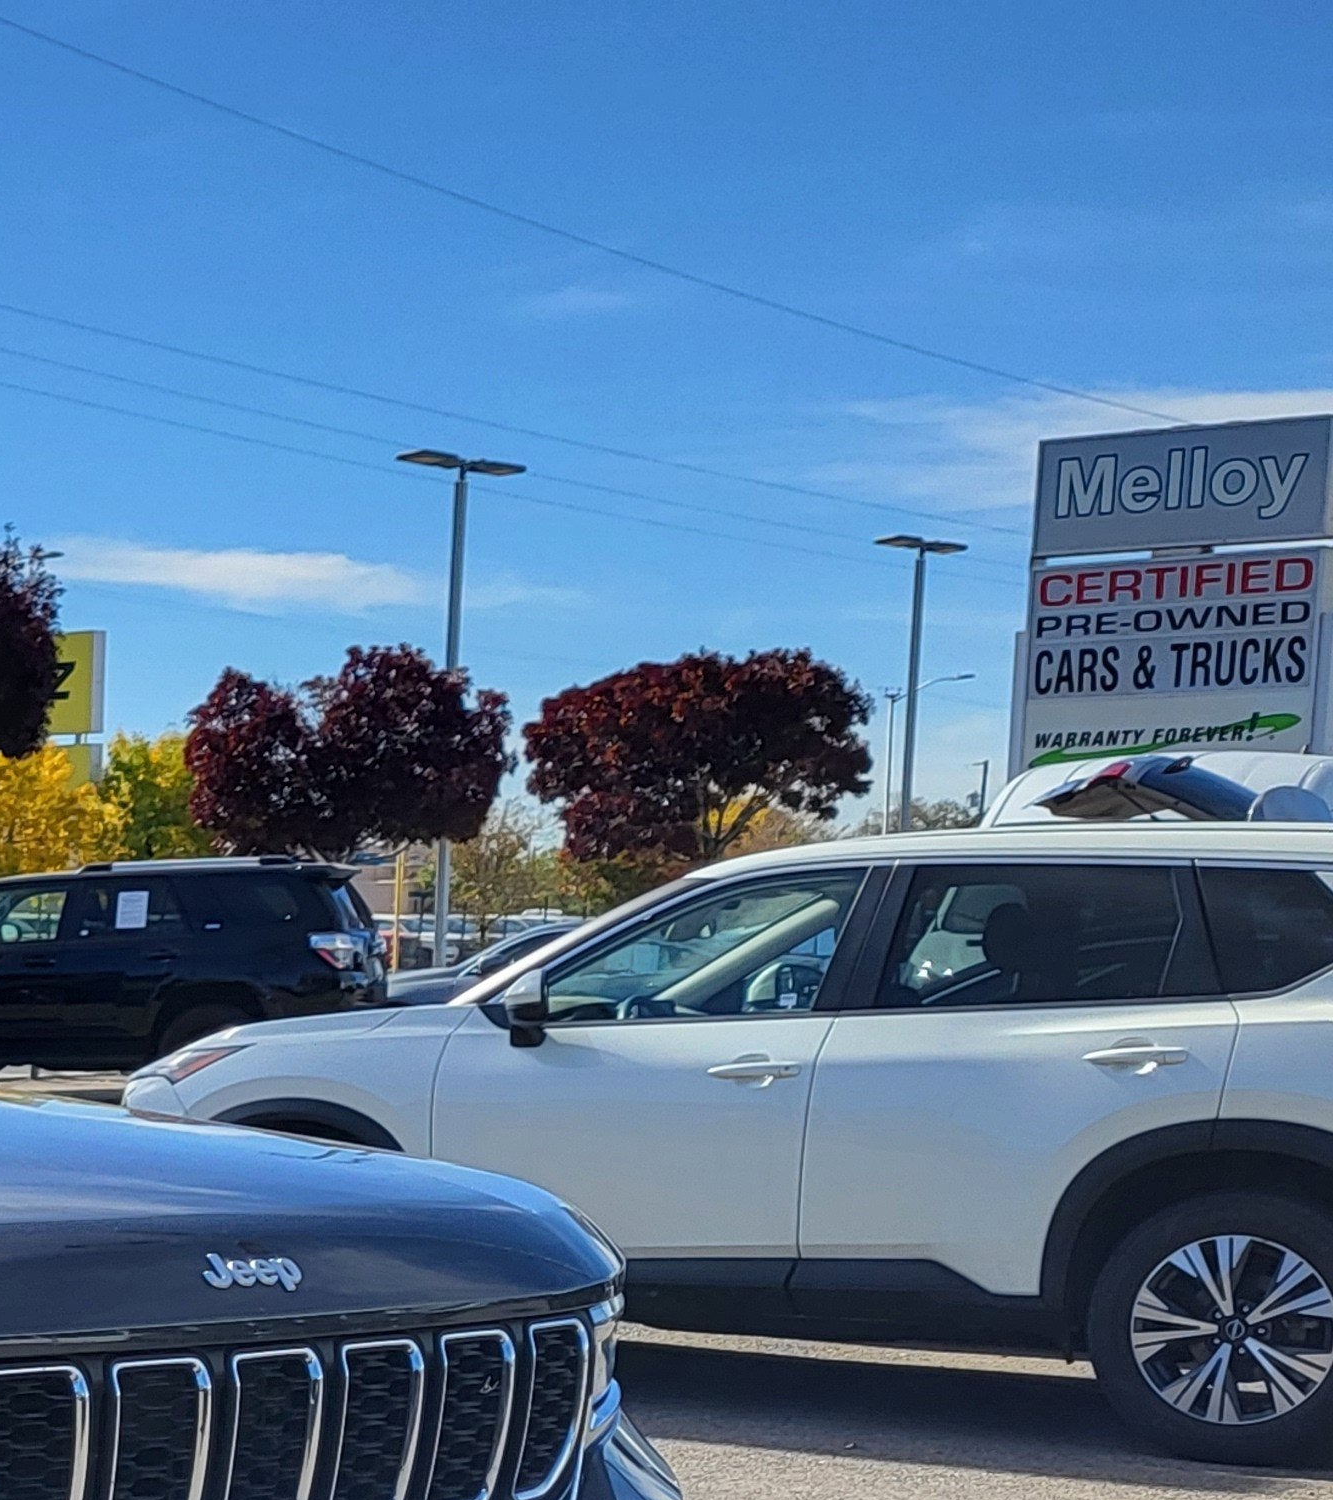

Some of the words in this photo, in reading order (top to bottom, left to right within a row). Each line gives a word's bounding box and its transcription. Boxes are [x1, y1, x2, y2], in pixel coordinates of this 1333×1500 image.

[1054, 445, 1309, 520] Melloy
[1039, 557, 1313, 607] CERTIFIED
[1036, 600, 1311, 638] PRE-OWNED
[1035, 645, 1119, 695] CARS
[1133, 645, 1156, 690] &
[1171, 635, 1307, 688] TRUCKS
[1035, 729, 1145, 749] WARRANTY
[201, 1252, 303, 1292] Jeep
